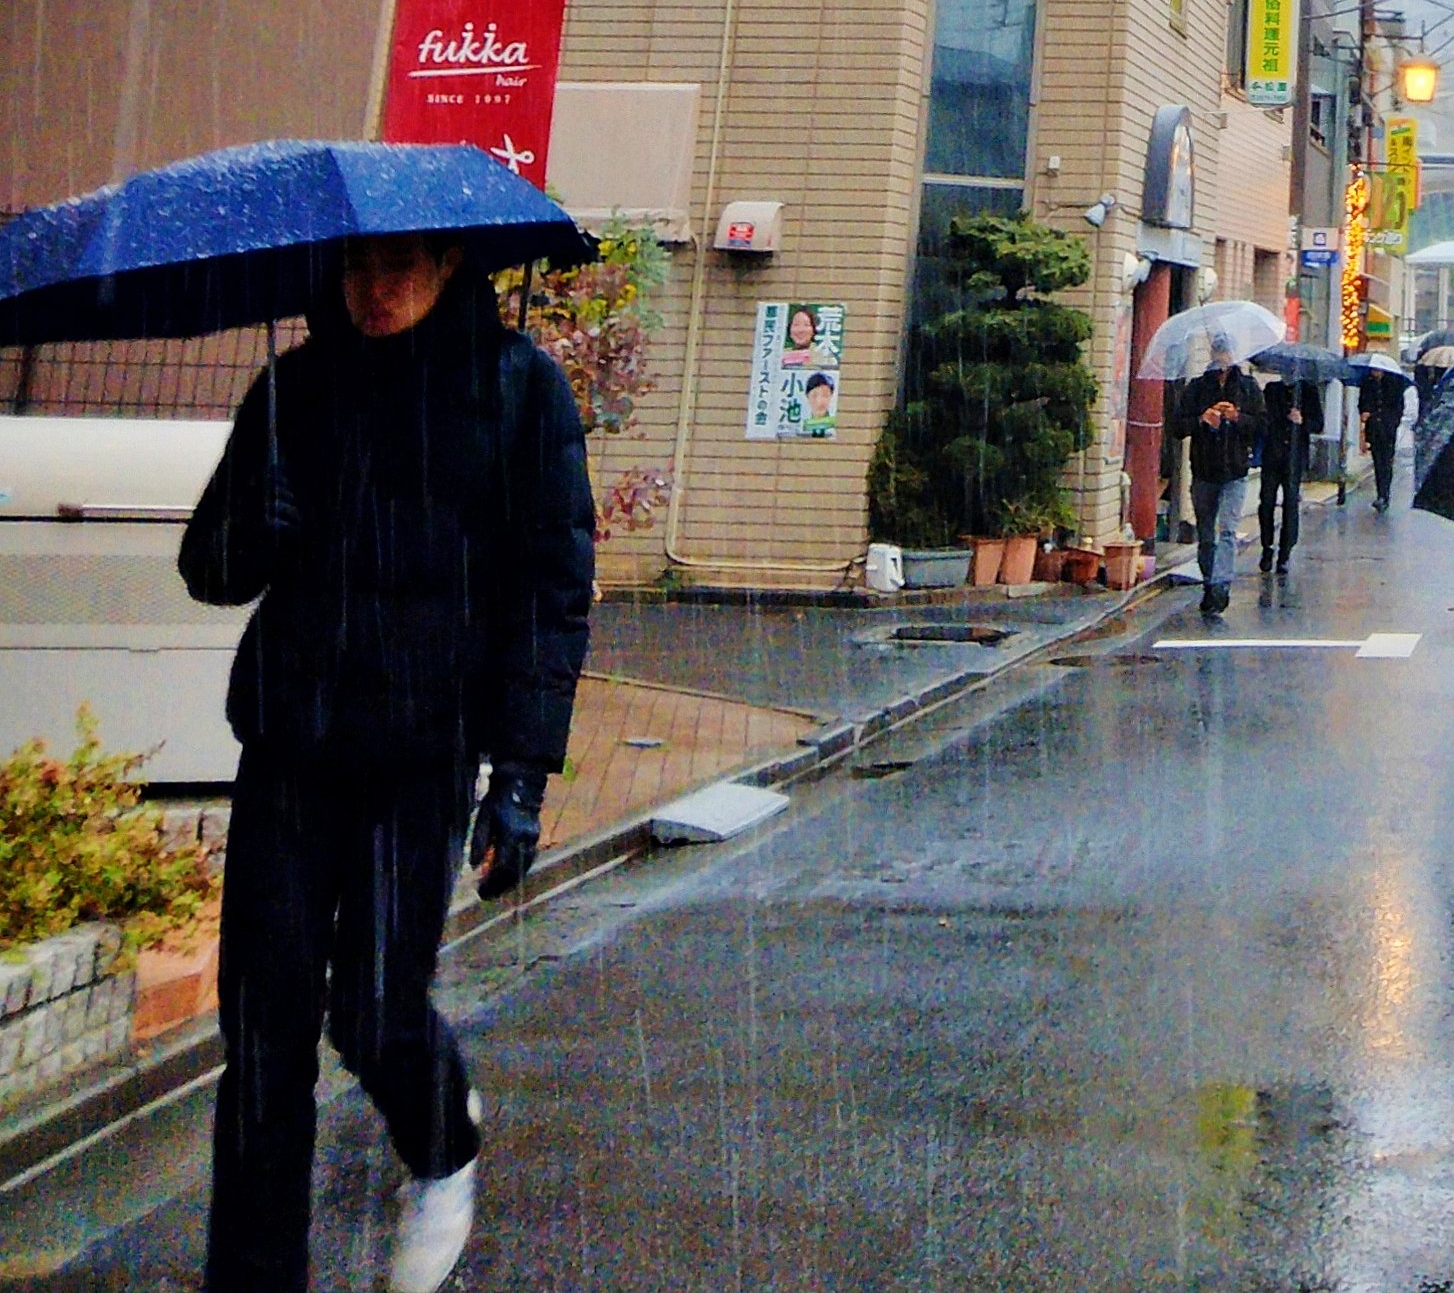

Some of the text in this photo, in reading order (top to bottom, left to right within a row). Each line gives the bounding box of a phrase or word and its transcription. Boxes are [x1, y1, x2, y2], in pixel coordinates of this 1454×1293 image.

[418, 22, 530, 64] fukka
[495, 74, 528, 87] hair
[427, 94, 464, 105] SINCE
[779, 372, 804, 424] 小池
